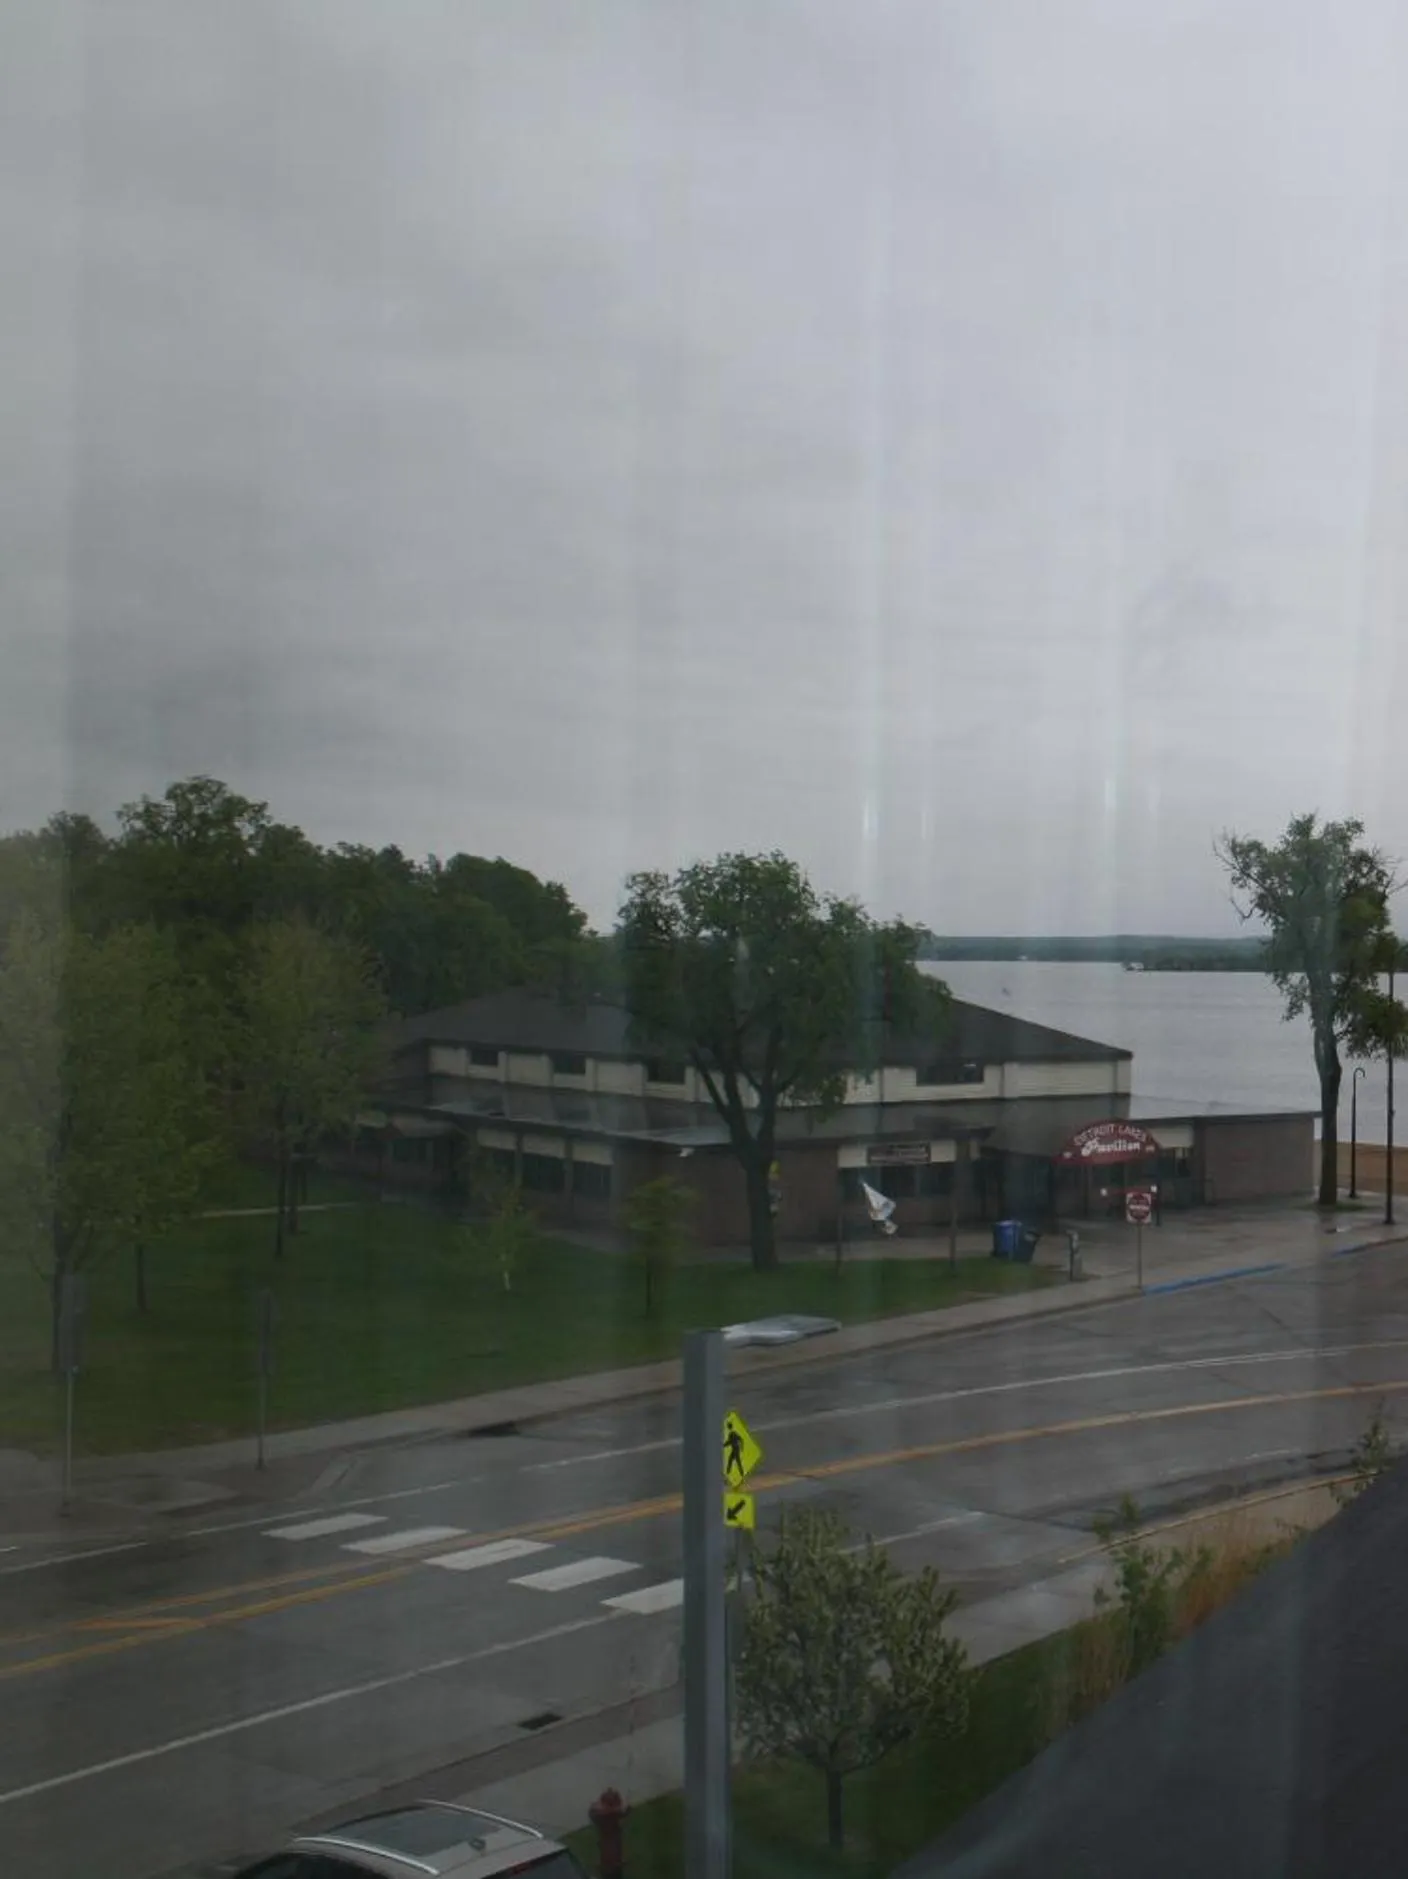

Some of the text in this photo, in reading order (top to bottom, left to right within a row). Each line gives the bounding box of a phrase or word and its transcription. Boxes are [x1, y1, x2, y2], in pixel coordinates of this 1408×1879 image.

[1073, 1123, 1147, 1146] DETROIT LAKES
[1081, 1136, 1141, 1157] Pavilion
